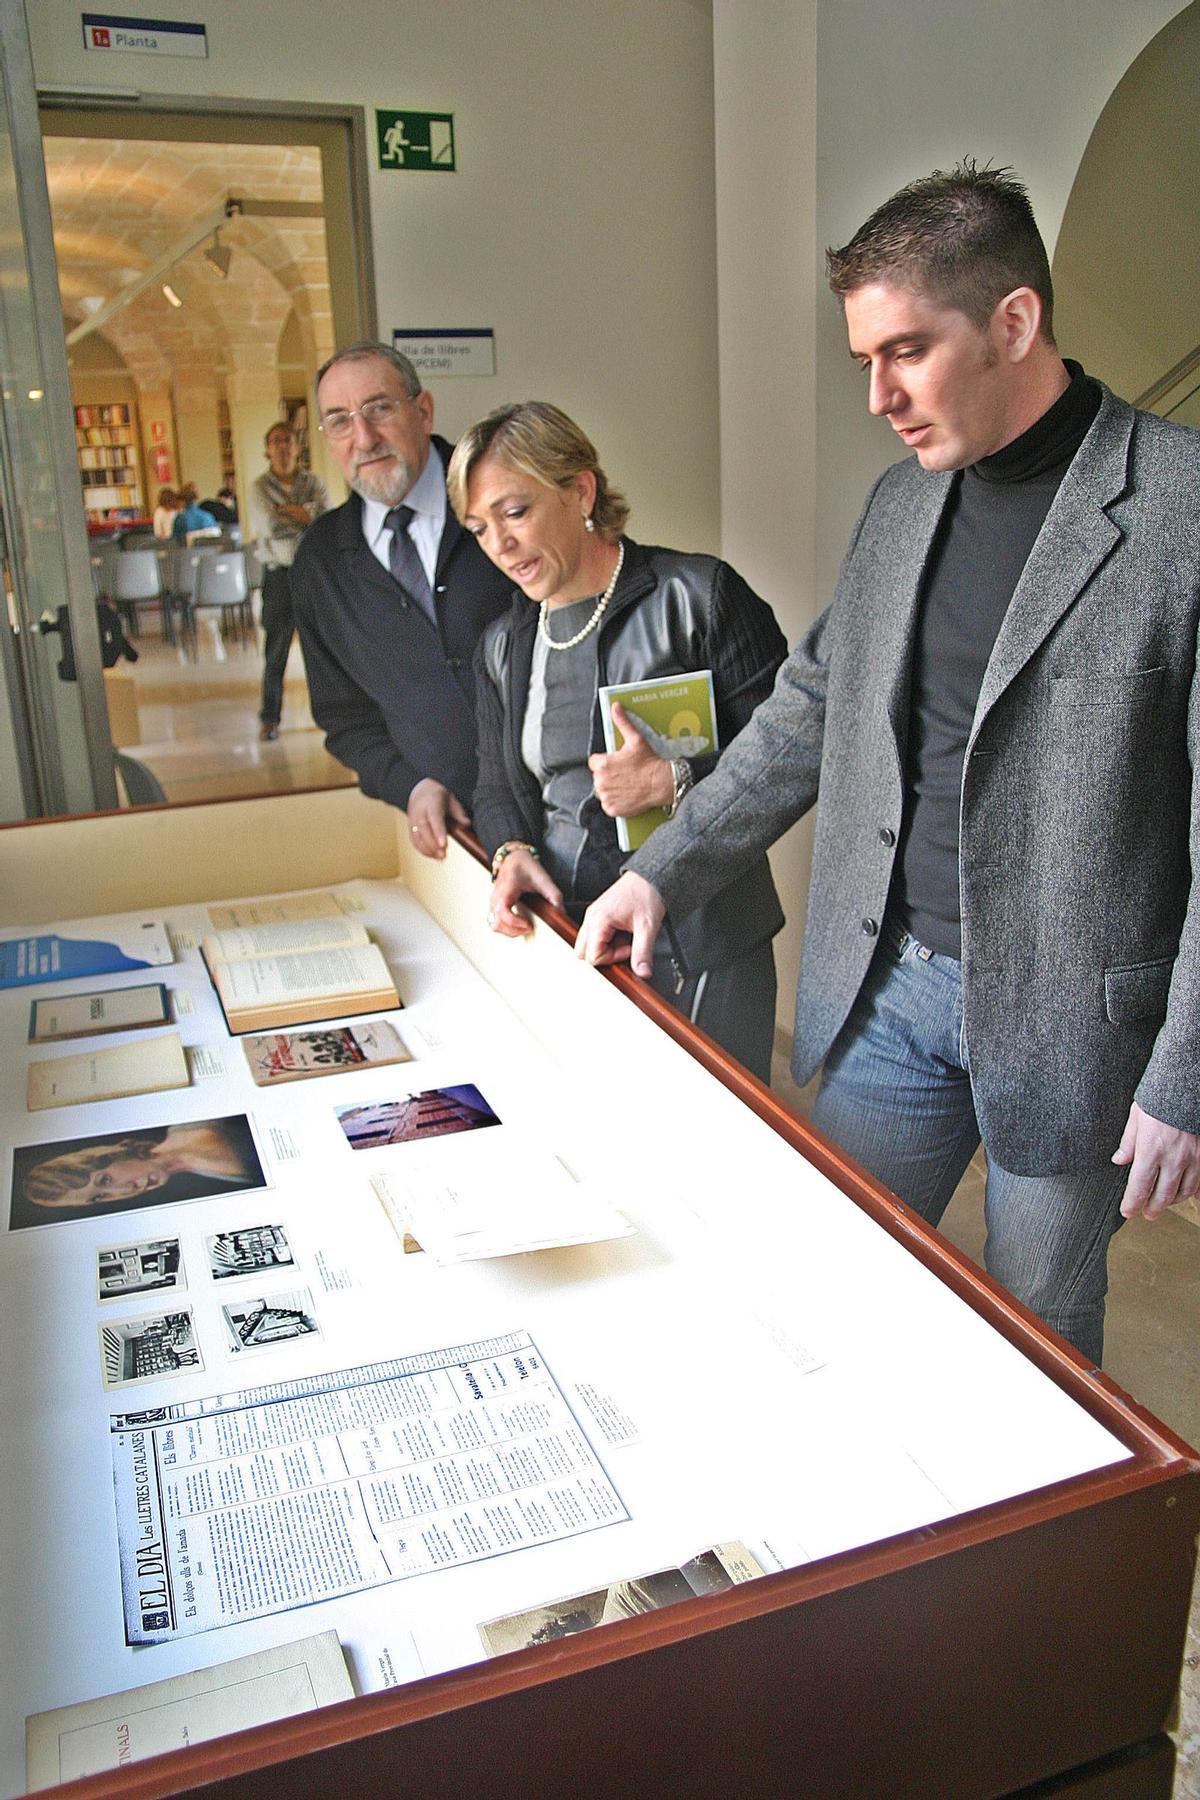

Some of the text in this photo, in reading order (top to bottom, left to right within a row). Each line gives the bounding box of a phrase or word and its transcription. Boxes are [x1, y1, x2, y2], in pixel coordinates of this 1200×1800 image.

[115, 33, 158, 48] Planta
[659, 686, 689, 700] VERGER
[160, 1430, 177, 1465] Els llibres
[131, 1432, 154, 1541] Les LLETRES CATALANES
[178, 1554, 190, 1564] de
[135, 1541, 168, 1611] EL DIA
[179, 1566, 192, 1579] ulls
[181, 1580, 196, 1603] dolços
[184, 1604, 198, 1618] Els
